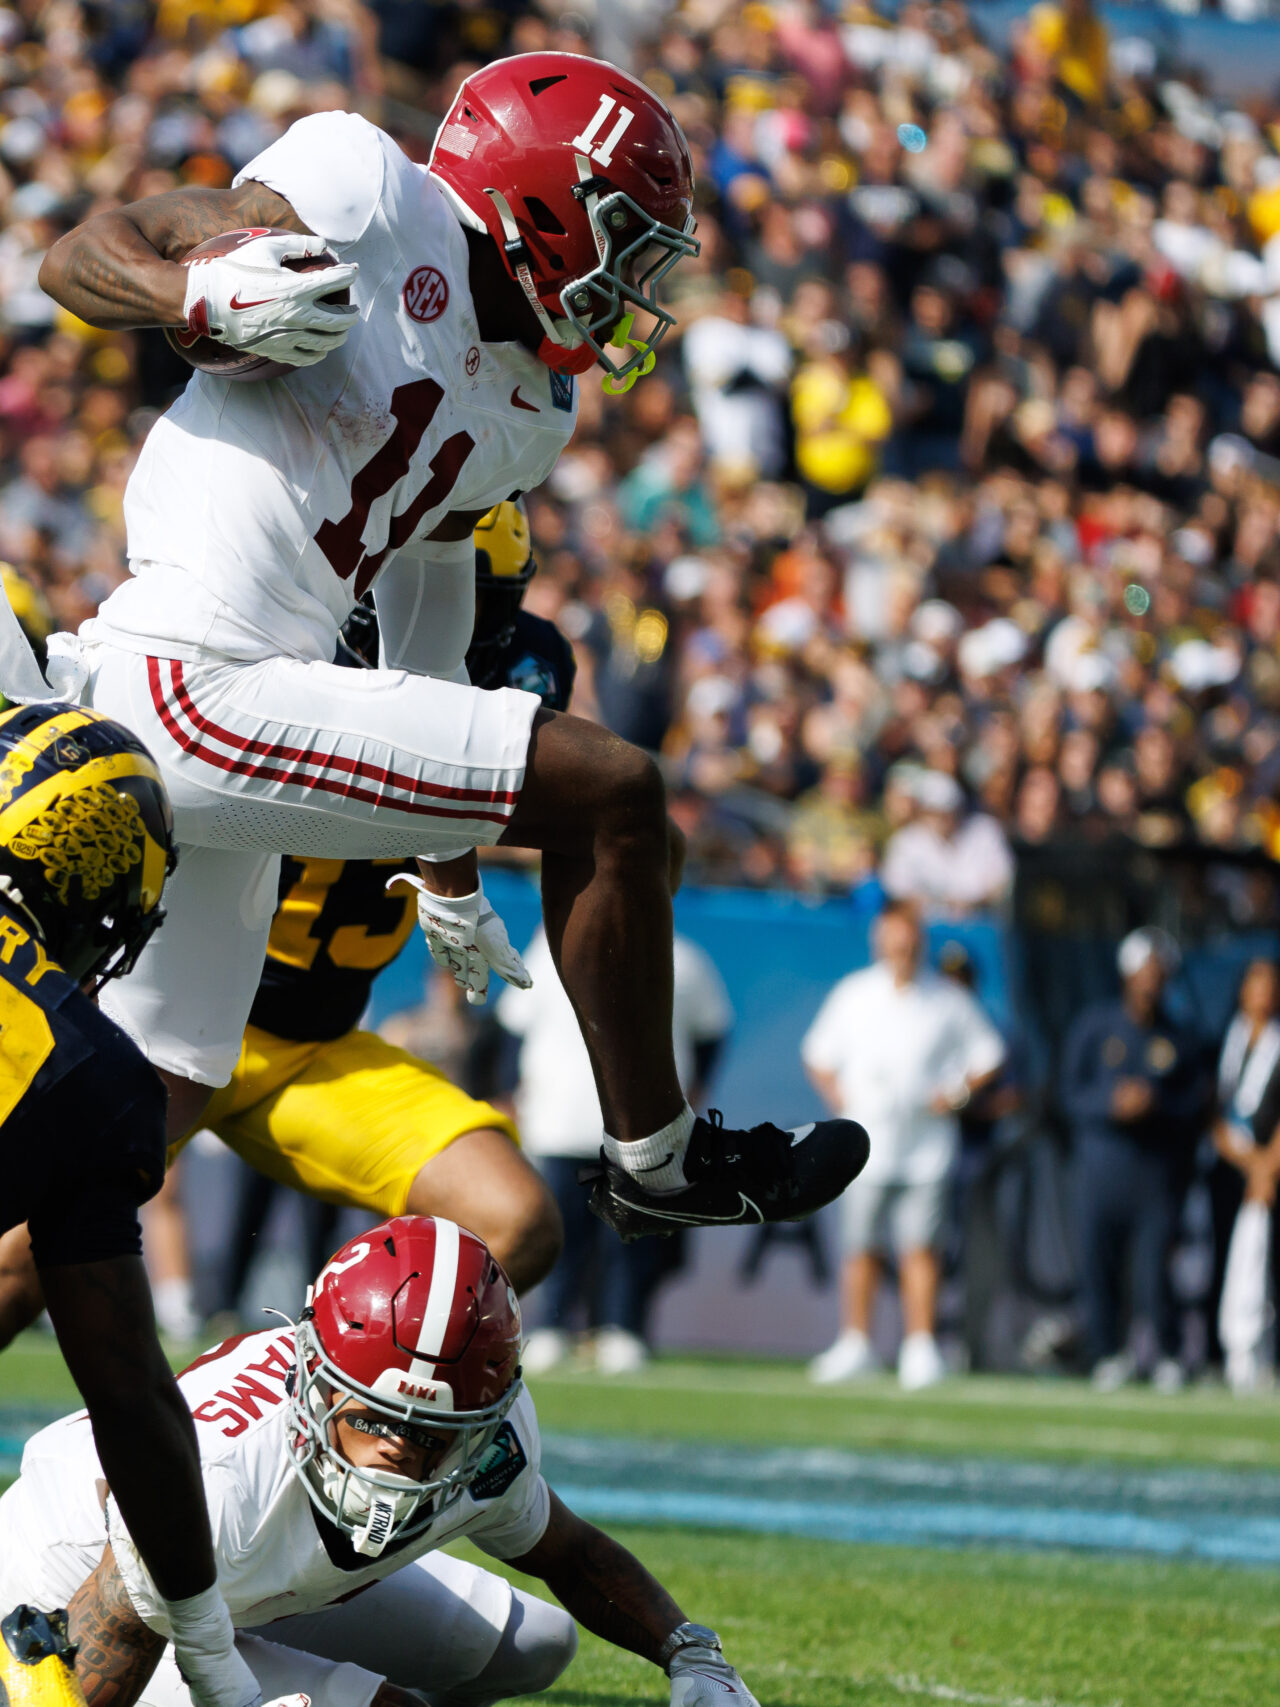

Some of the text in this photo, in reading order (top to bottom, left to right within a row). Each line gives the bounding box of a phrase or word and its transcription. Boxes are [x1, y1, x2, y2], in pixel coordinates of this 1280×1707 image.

[572, 94, 635, 168] 11
[406, 270, 446, 319] SEC
[314, 378, 475, 601] 11
[397, 1379, 438, 1402] BAMA
[367, 1499, 394, 1546] NXTRND
